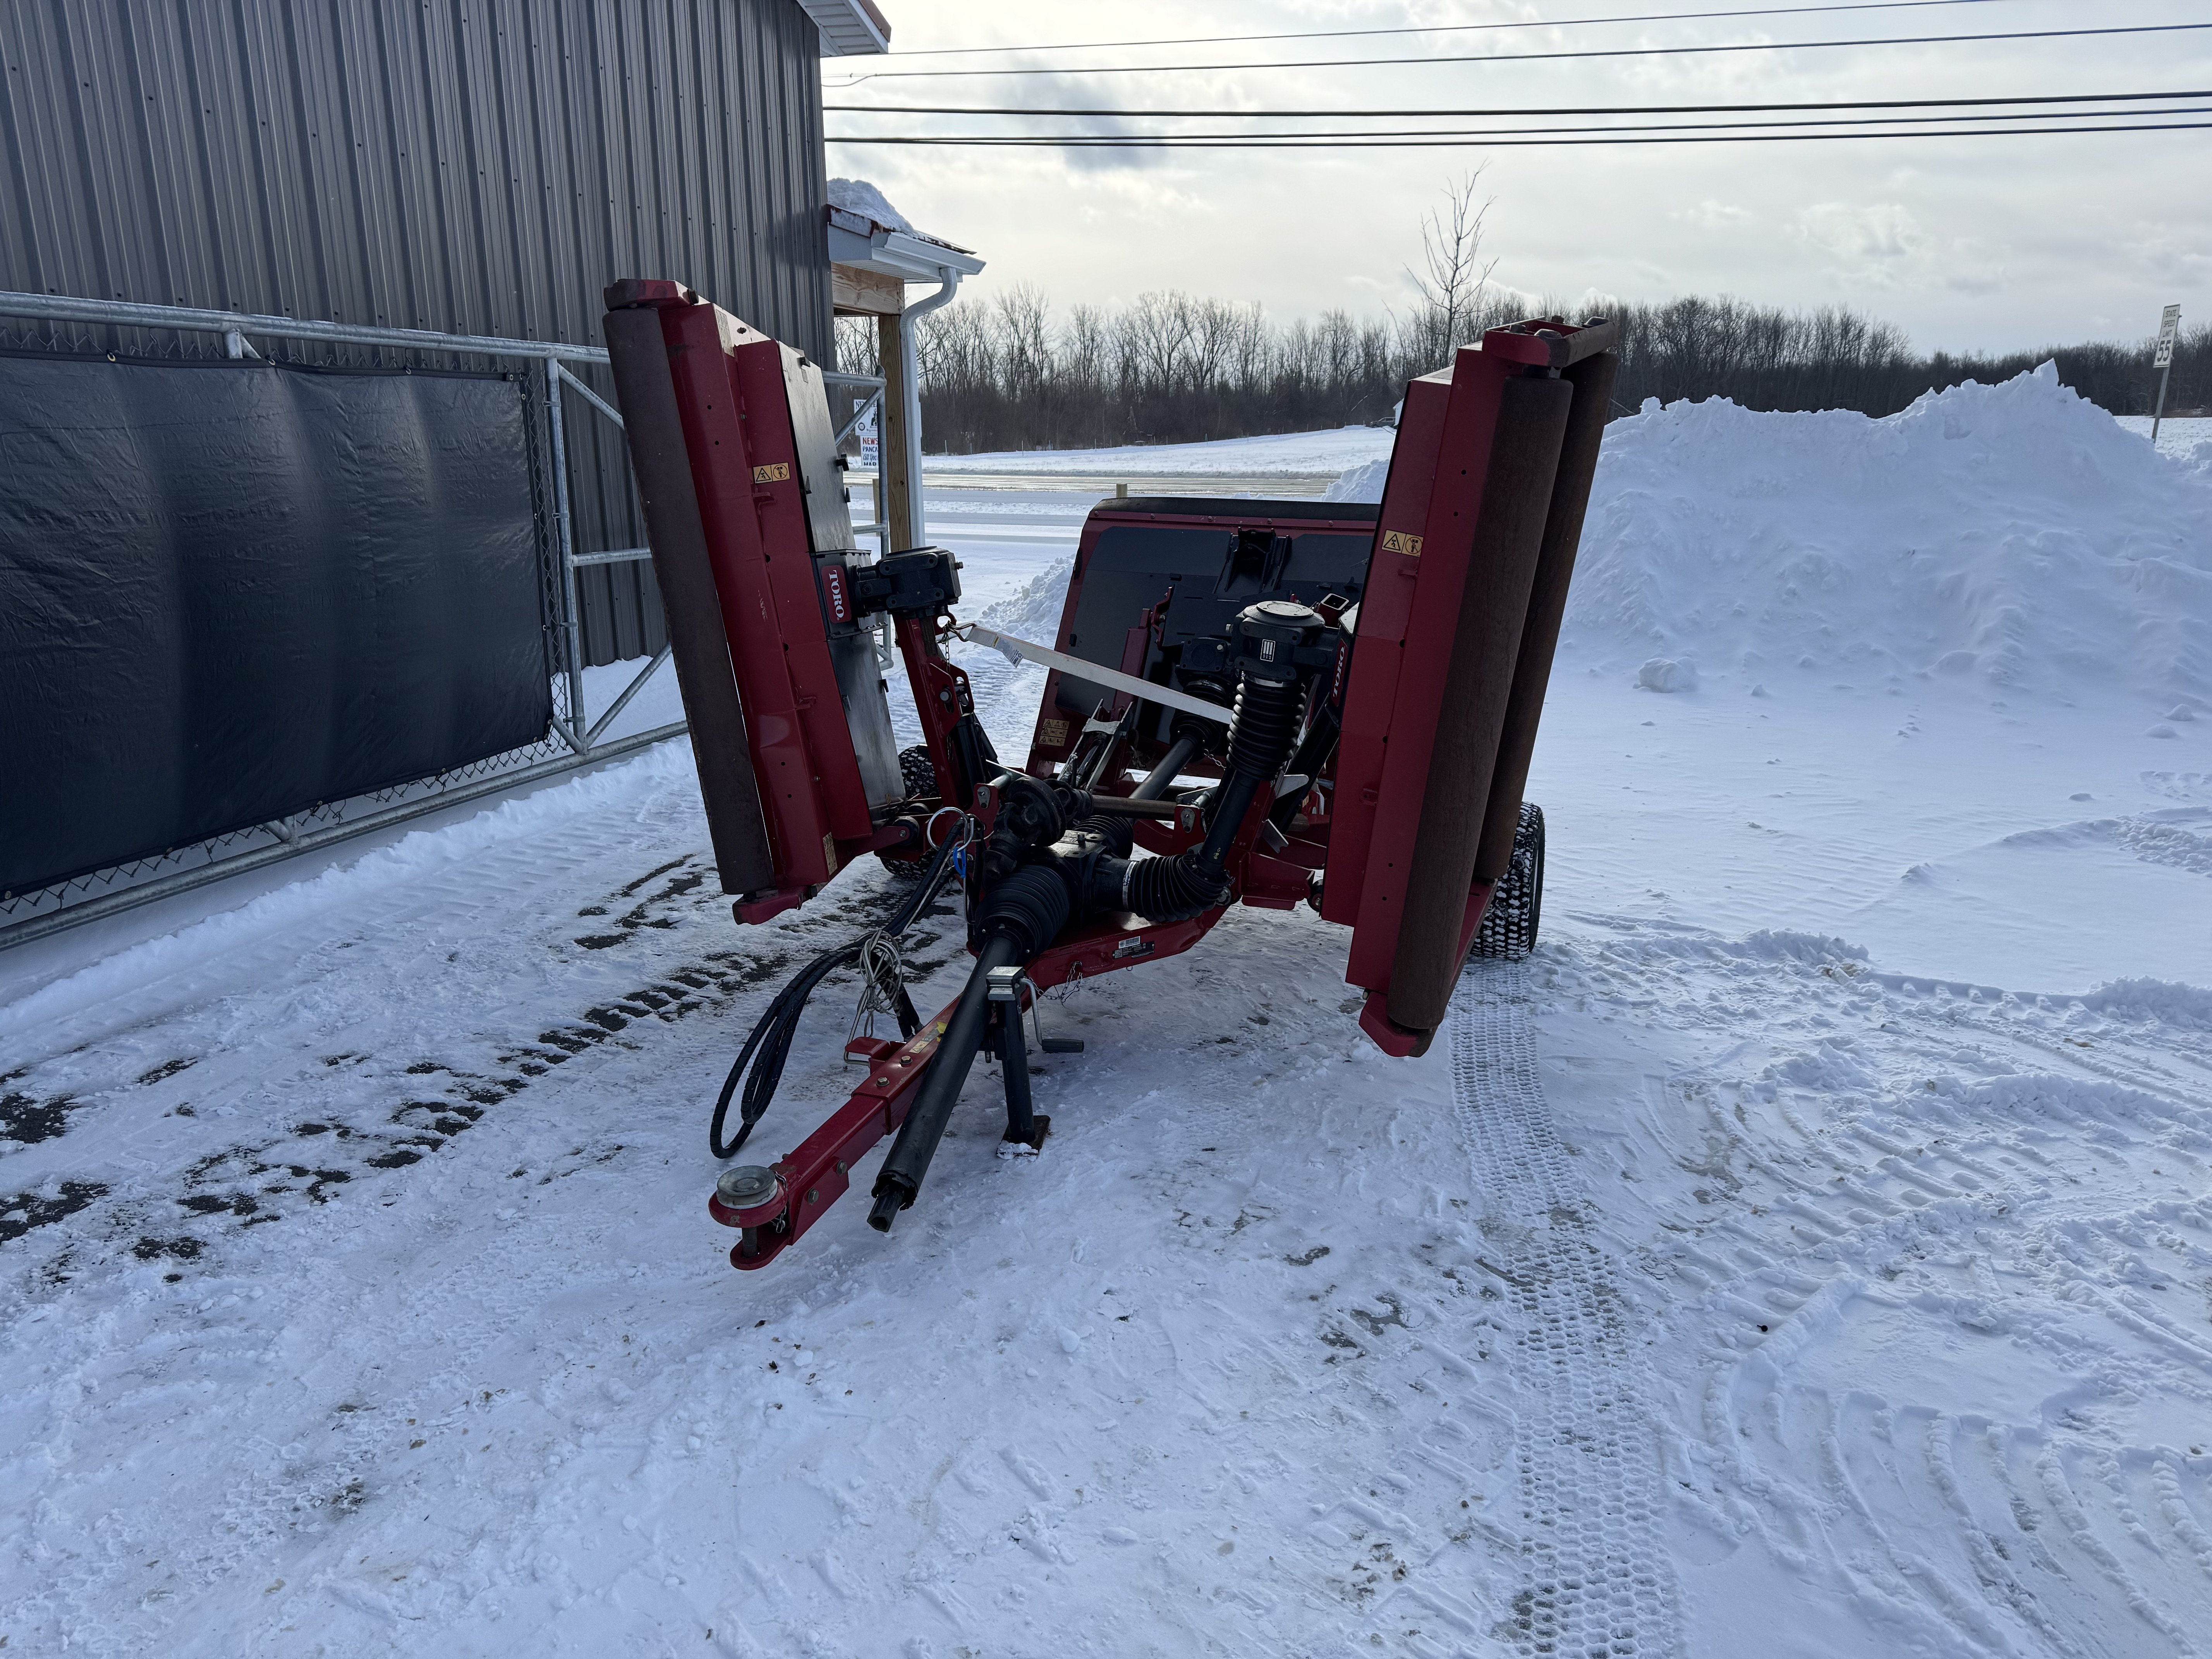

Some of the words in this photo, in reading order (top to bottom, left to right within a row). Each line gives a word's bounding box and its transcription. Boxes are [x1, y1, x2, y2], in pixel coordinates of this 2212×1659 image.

[2165, 309, 2176, 318] STATE
[2157, 340, 2172, 362] 55
[829, 570, 844, 618] TORO
[1333, 646, 1345, 697] TORO
